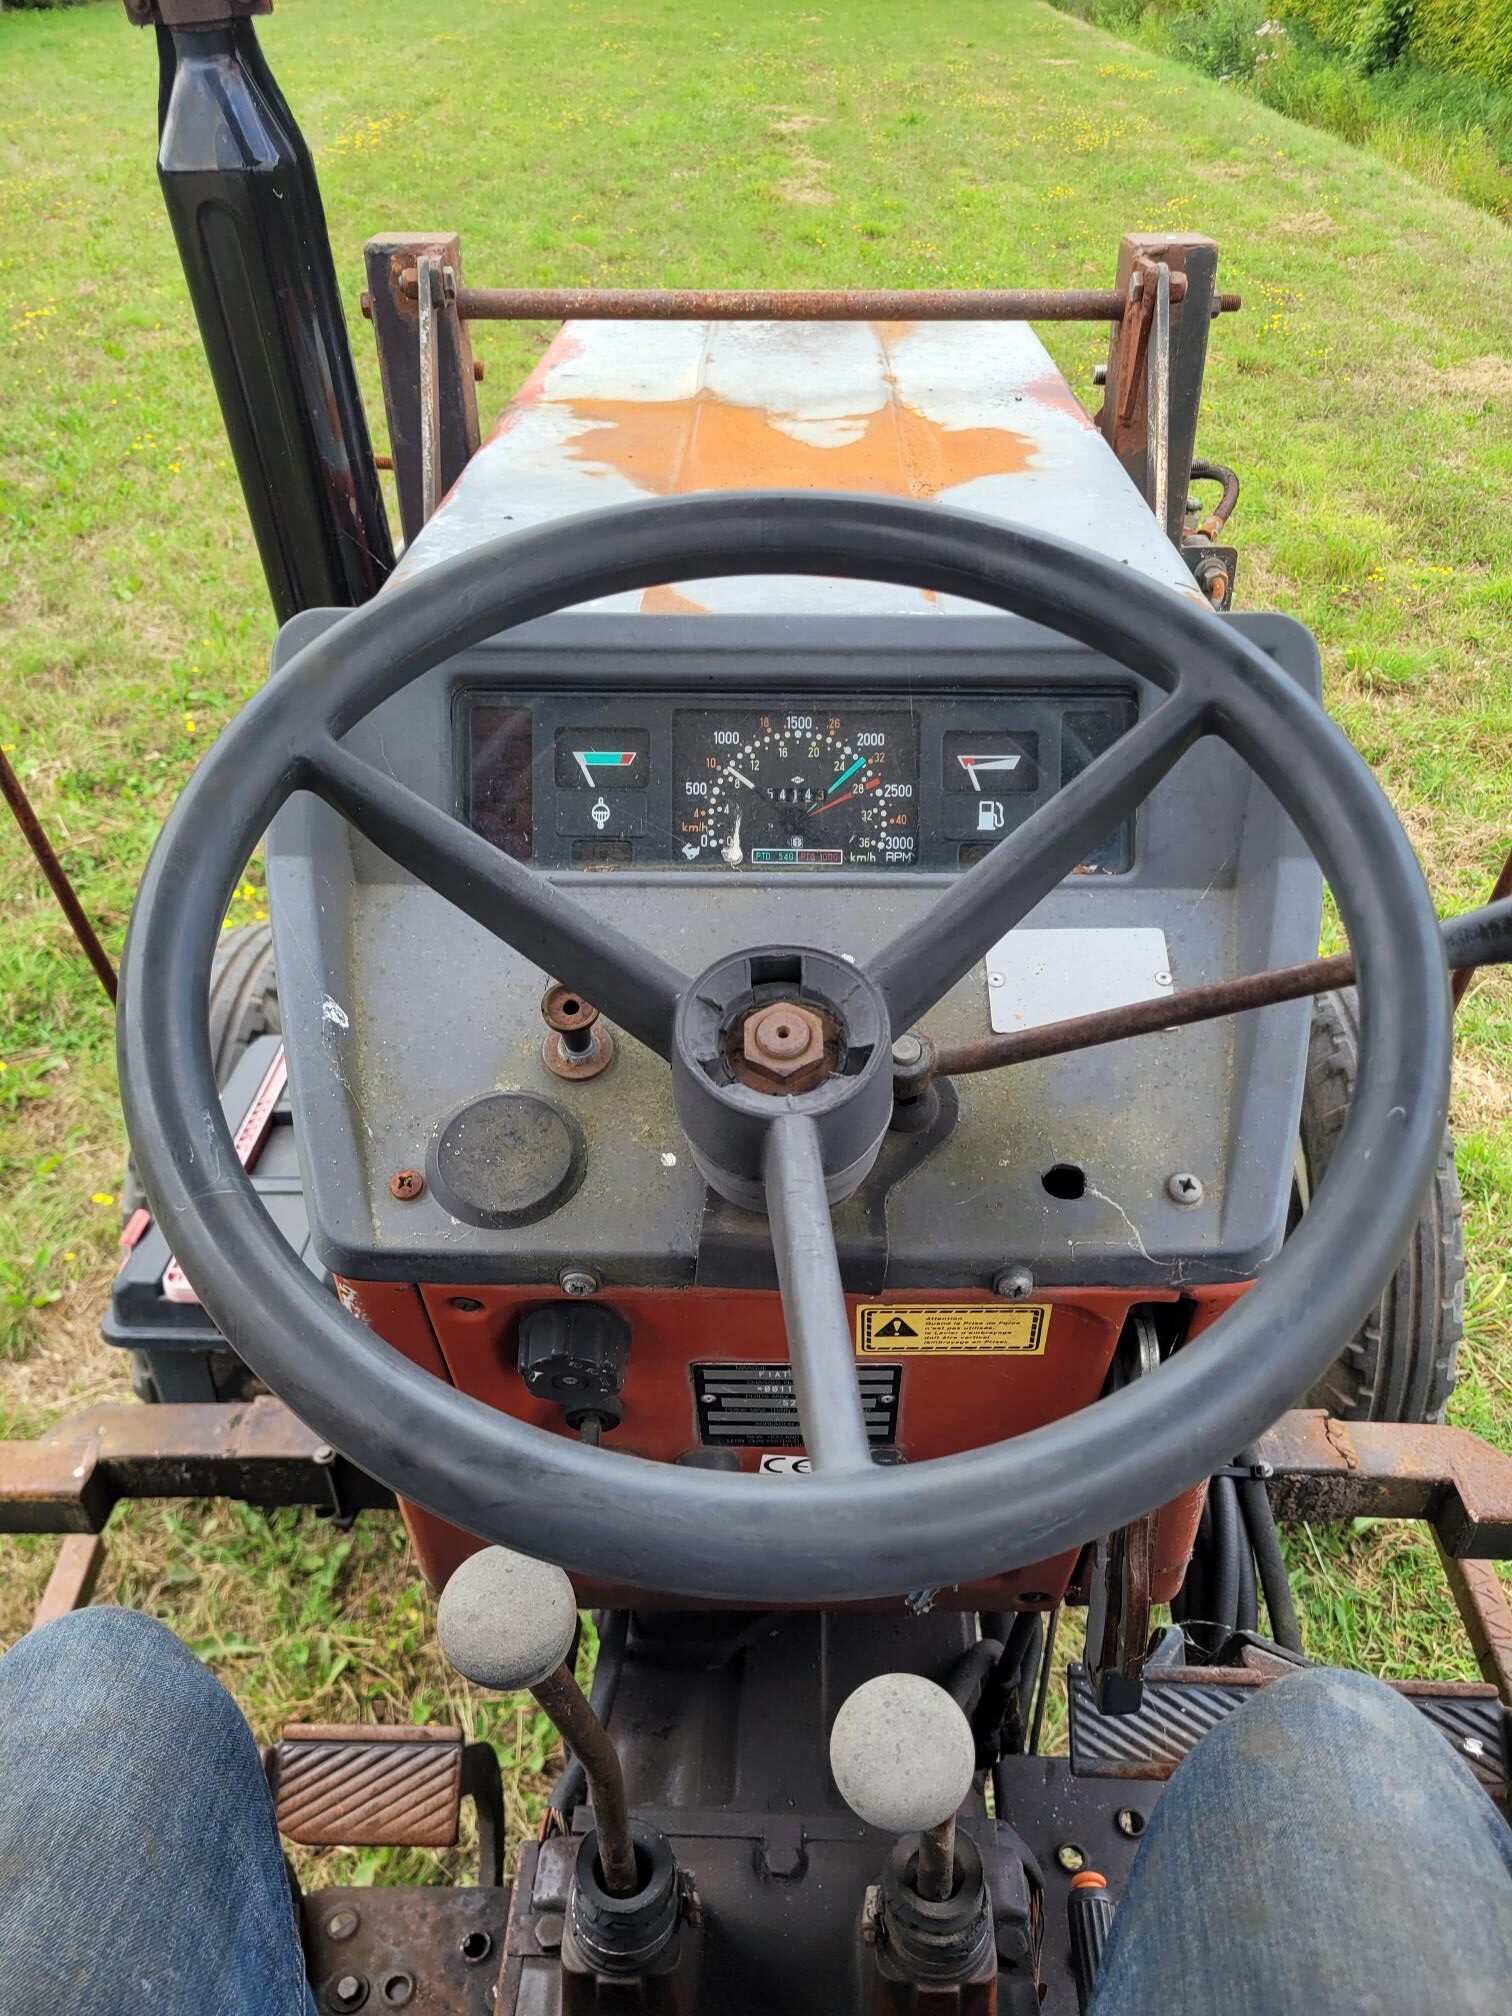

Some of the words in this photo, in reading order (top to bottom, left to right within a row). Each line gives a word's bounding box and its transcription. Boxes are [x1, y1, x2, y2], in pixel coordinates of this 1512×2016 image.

[760, 717, 769, 728] 18
[786, 716, 812, 730] 1500
[829, 719, 841, 729] 26
[713, 731, 740, 745] 1000
[856, 733, 885, 746] 2000
[778, 747, 788, 758] 16
[808, 747, 820, 758] 20
[874, 753, 886, 763] 32
[706, 758, 717, 768] 10
[750, 760, 760, 771] 12
[834, 761, 845, 772] 24
[685, 782, 707, 795] 500
[734, 778, 741, 789] 8
[853, 783, 864, 794] 28
[884, 784, 913, 798] 2500
[693, 808, 699, 818] 4
[723, 803, 730, 814] 4
[861, 811, 873, 821] 32
[894, 815, 907, 825] 40
[682, 821, 708, 833] km/h
[700, 834, 708, 848] 0
[859, 837, 870, 848] 36
[885, 836, 914, 850] 3000
[778, 852, 794, 861] 540
[850, 852, 877, 863] km/h
[885, 852, 912, 863] RPM
[763, 1457, 811, 1474] CE
